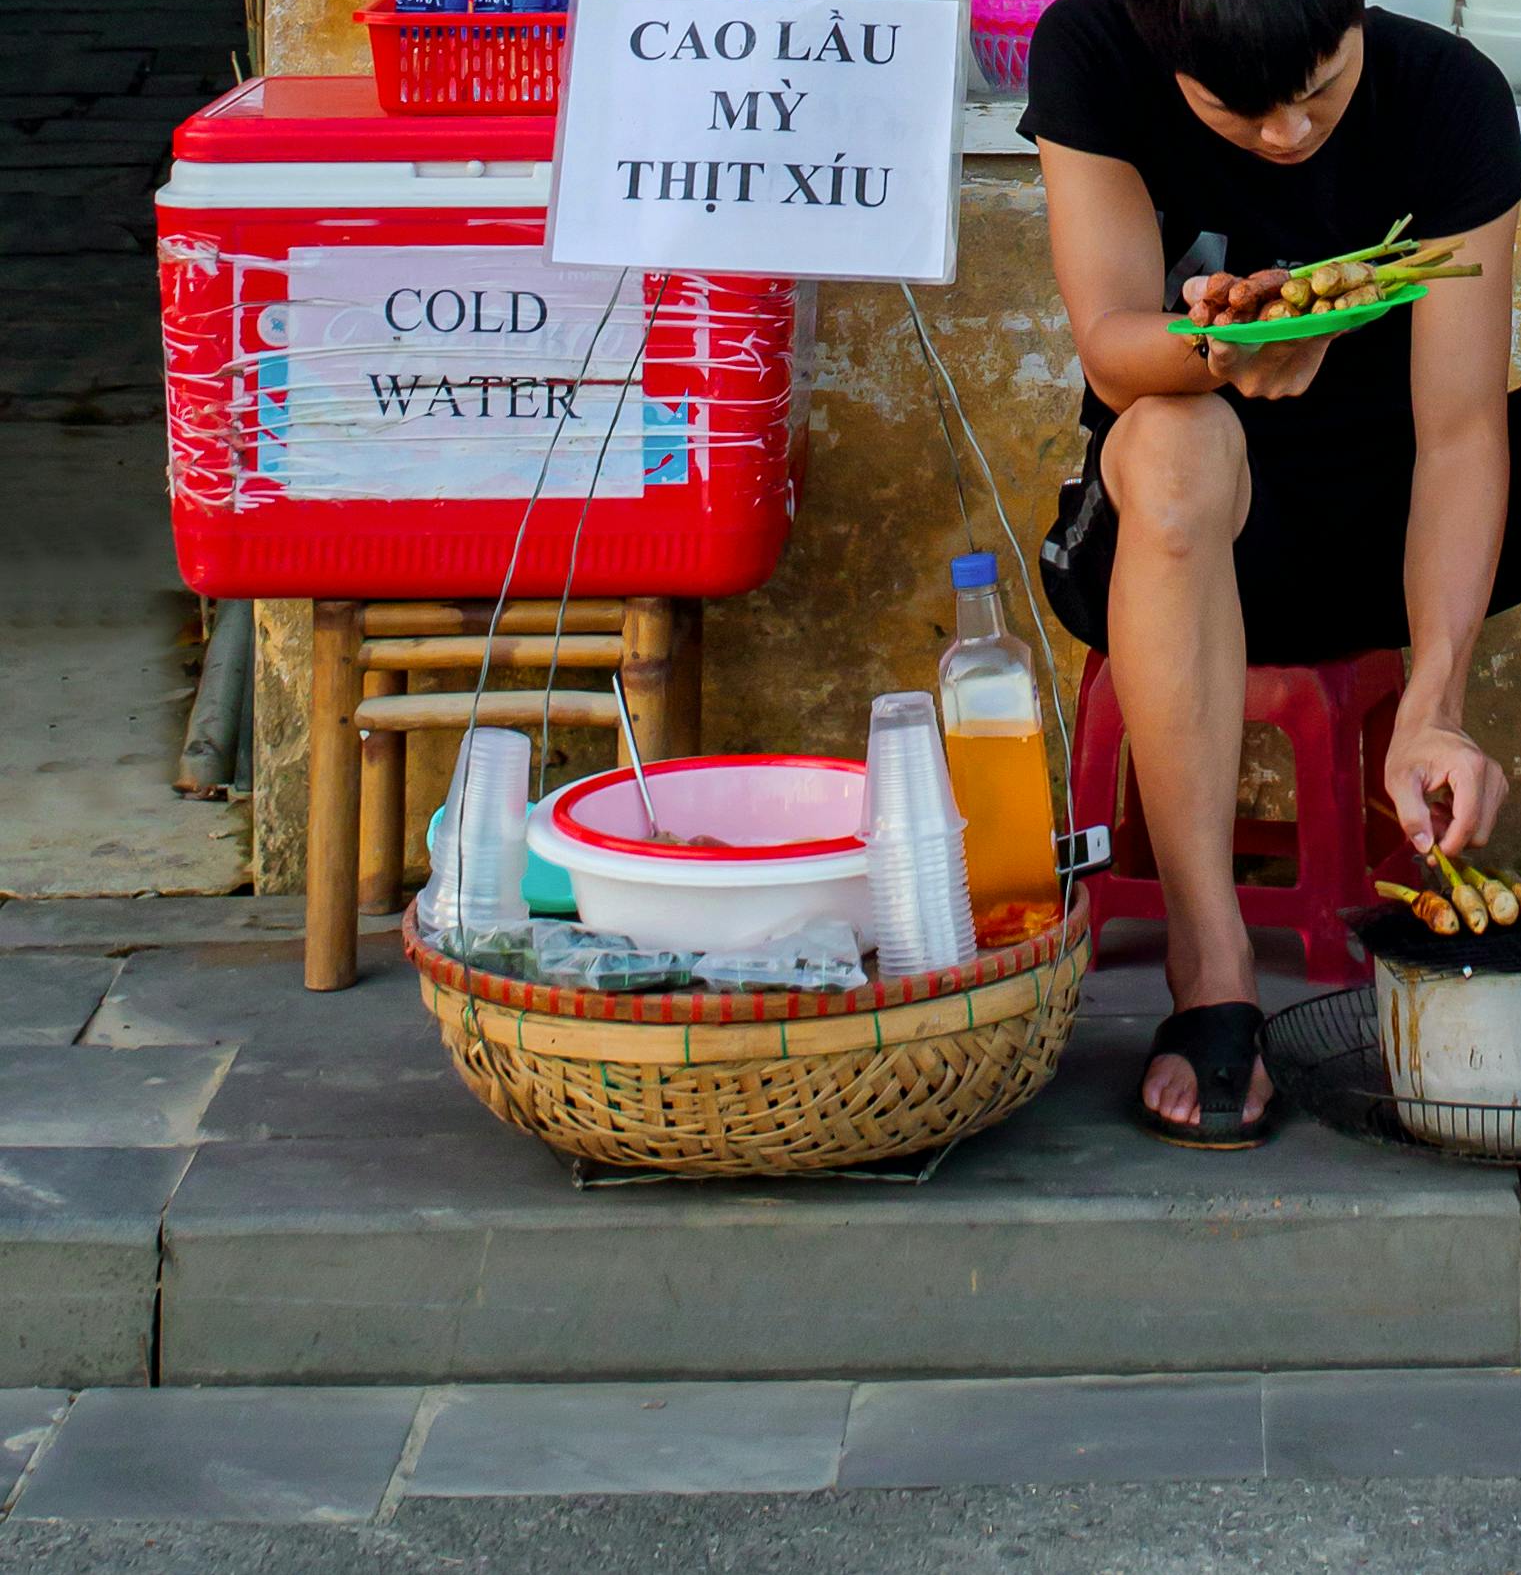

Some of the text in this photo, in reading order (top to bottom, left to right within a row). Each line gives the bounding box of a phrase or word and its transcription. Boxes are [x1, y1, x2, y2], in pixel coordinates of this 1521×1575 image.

[629, 9, 902, 65] CAO LẦU
[707, 78, 809, 132] MỲ
[617, 153, 893, 214] THỊT XÍU
[384, 287, 548, 334] COLD
[366, 373, 582, 420] WATER
